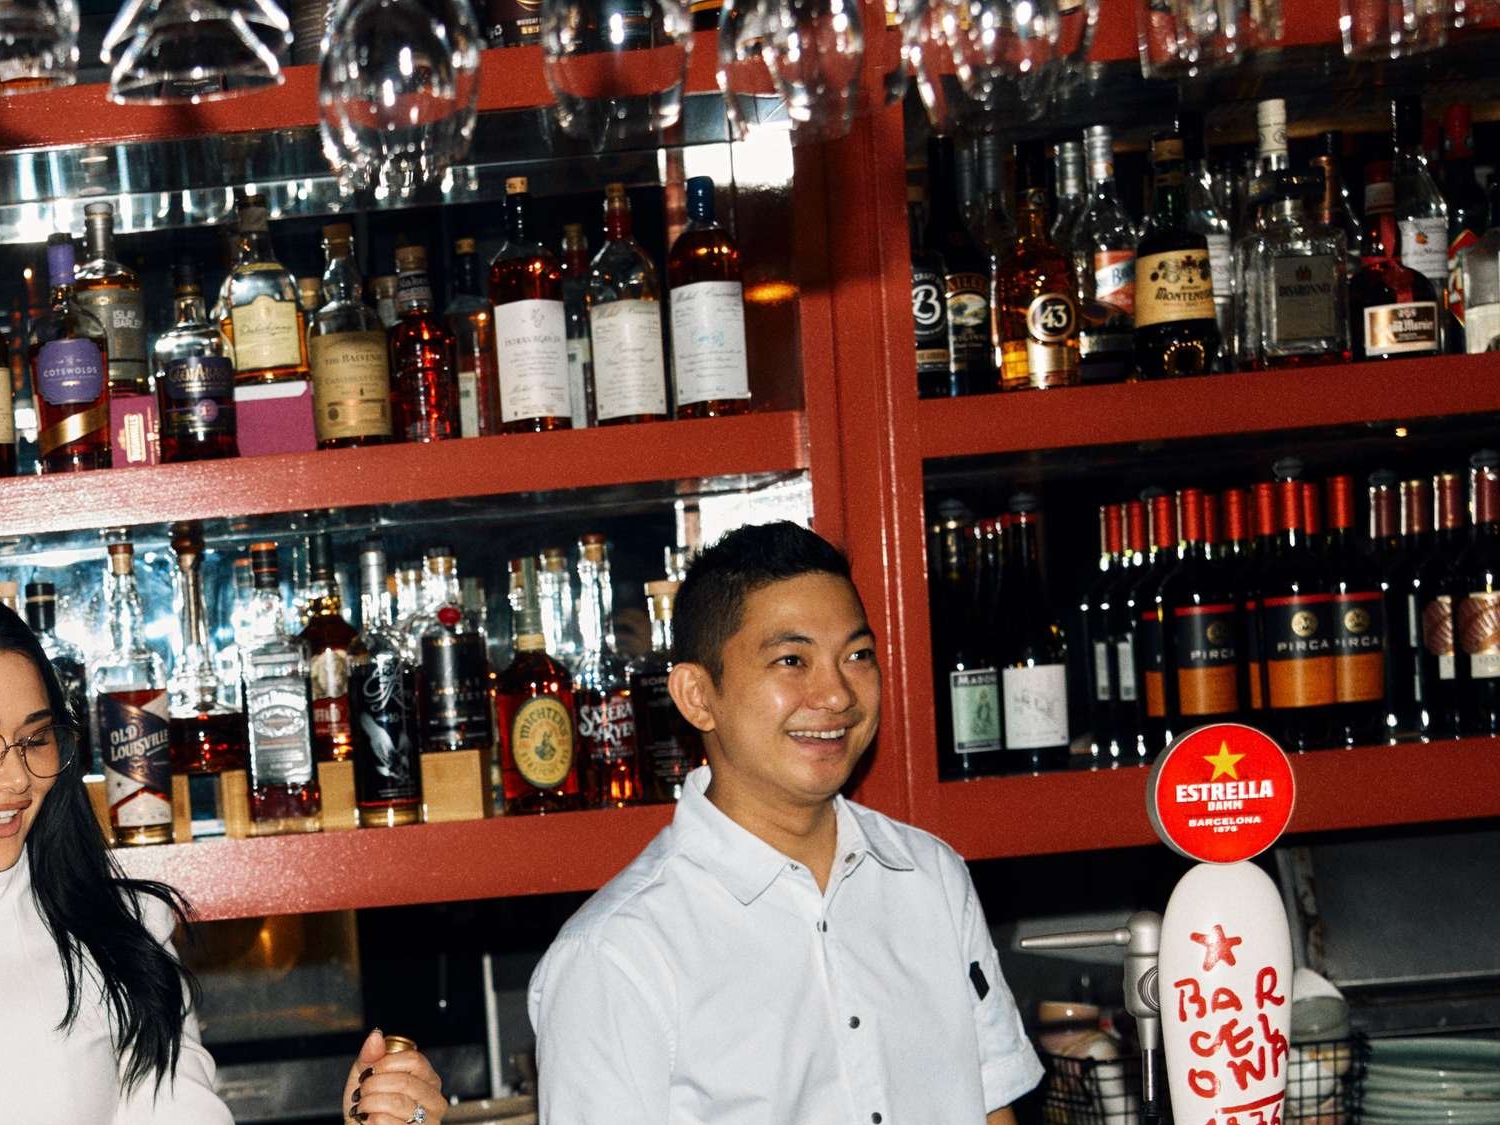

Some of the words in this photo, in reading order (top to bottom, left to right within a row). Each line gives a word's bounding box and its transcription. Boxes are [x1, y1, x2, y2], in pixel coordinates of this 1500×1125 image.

[1041, 304, 1068, 328] 43
[43, 365, 98, 377] COTSWOLDS
[1277, 639, 1329, 652] PIRCA
[110, 724, 138, 746] OLD
[110, 728, 169, 762] LOUISVILLE
[1175, 779, 1274, 803] ESTRELLA
[1207, 800, 1243, 812] DAMM
[1188, 815, 1262, 828] BARCELONA
[1213, 825, 1239, 833] 1876
[1173, 965, 1286, 1023] BAR
